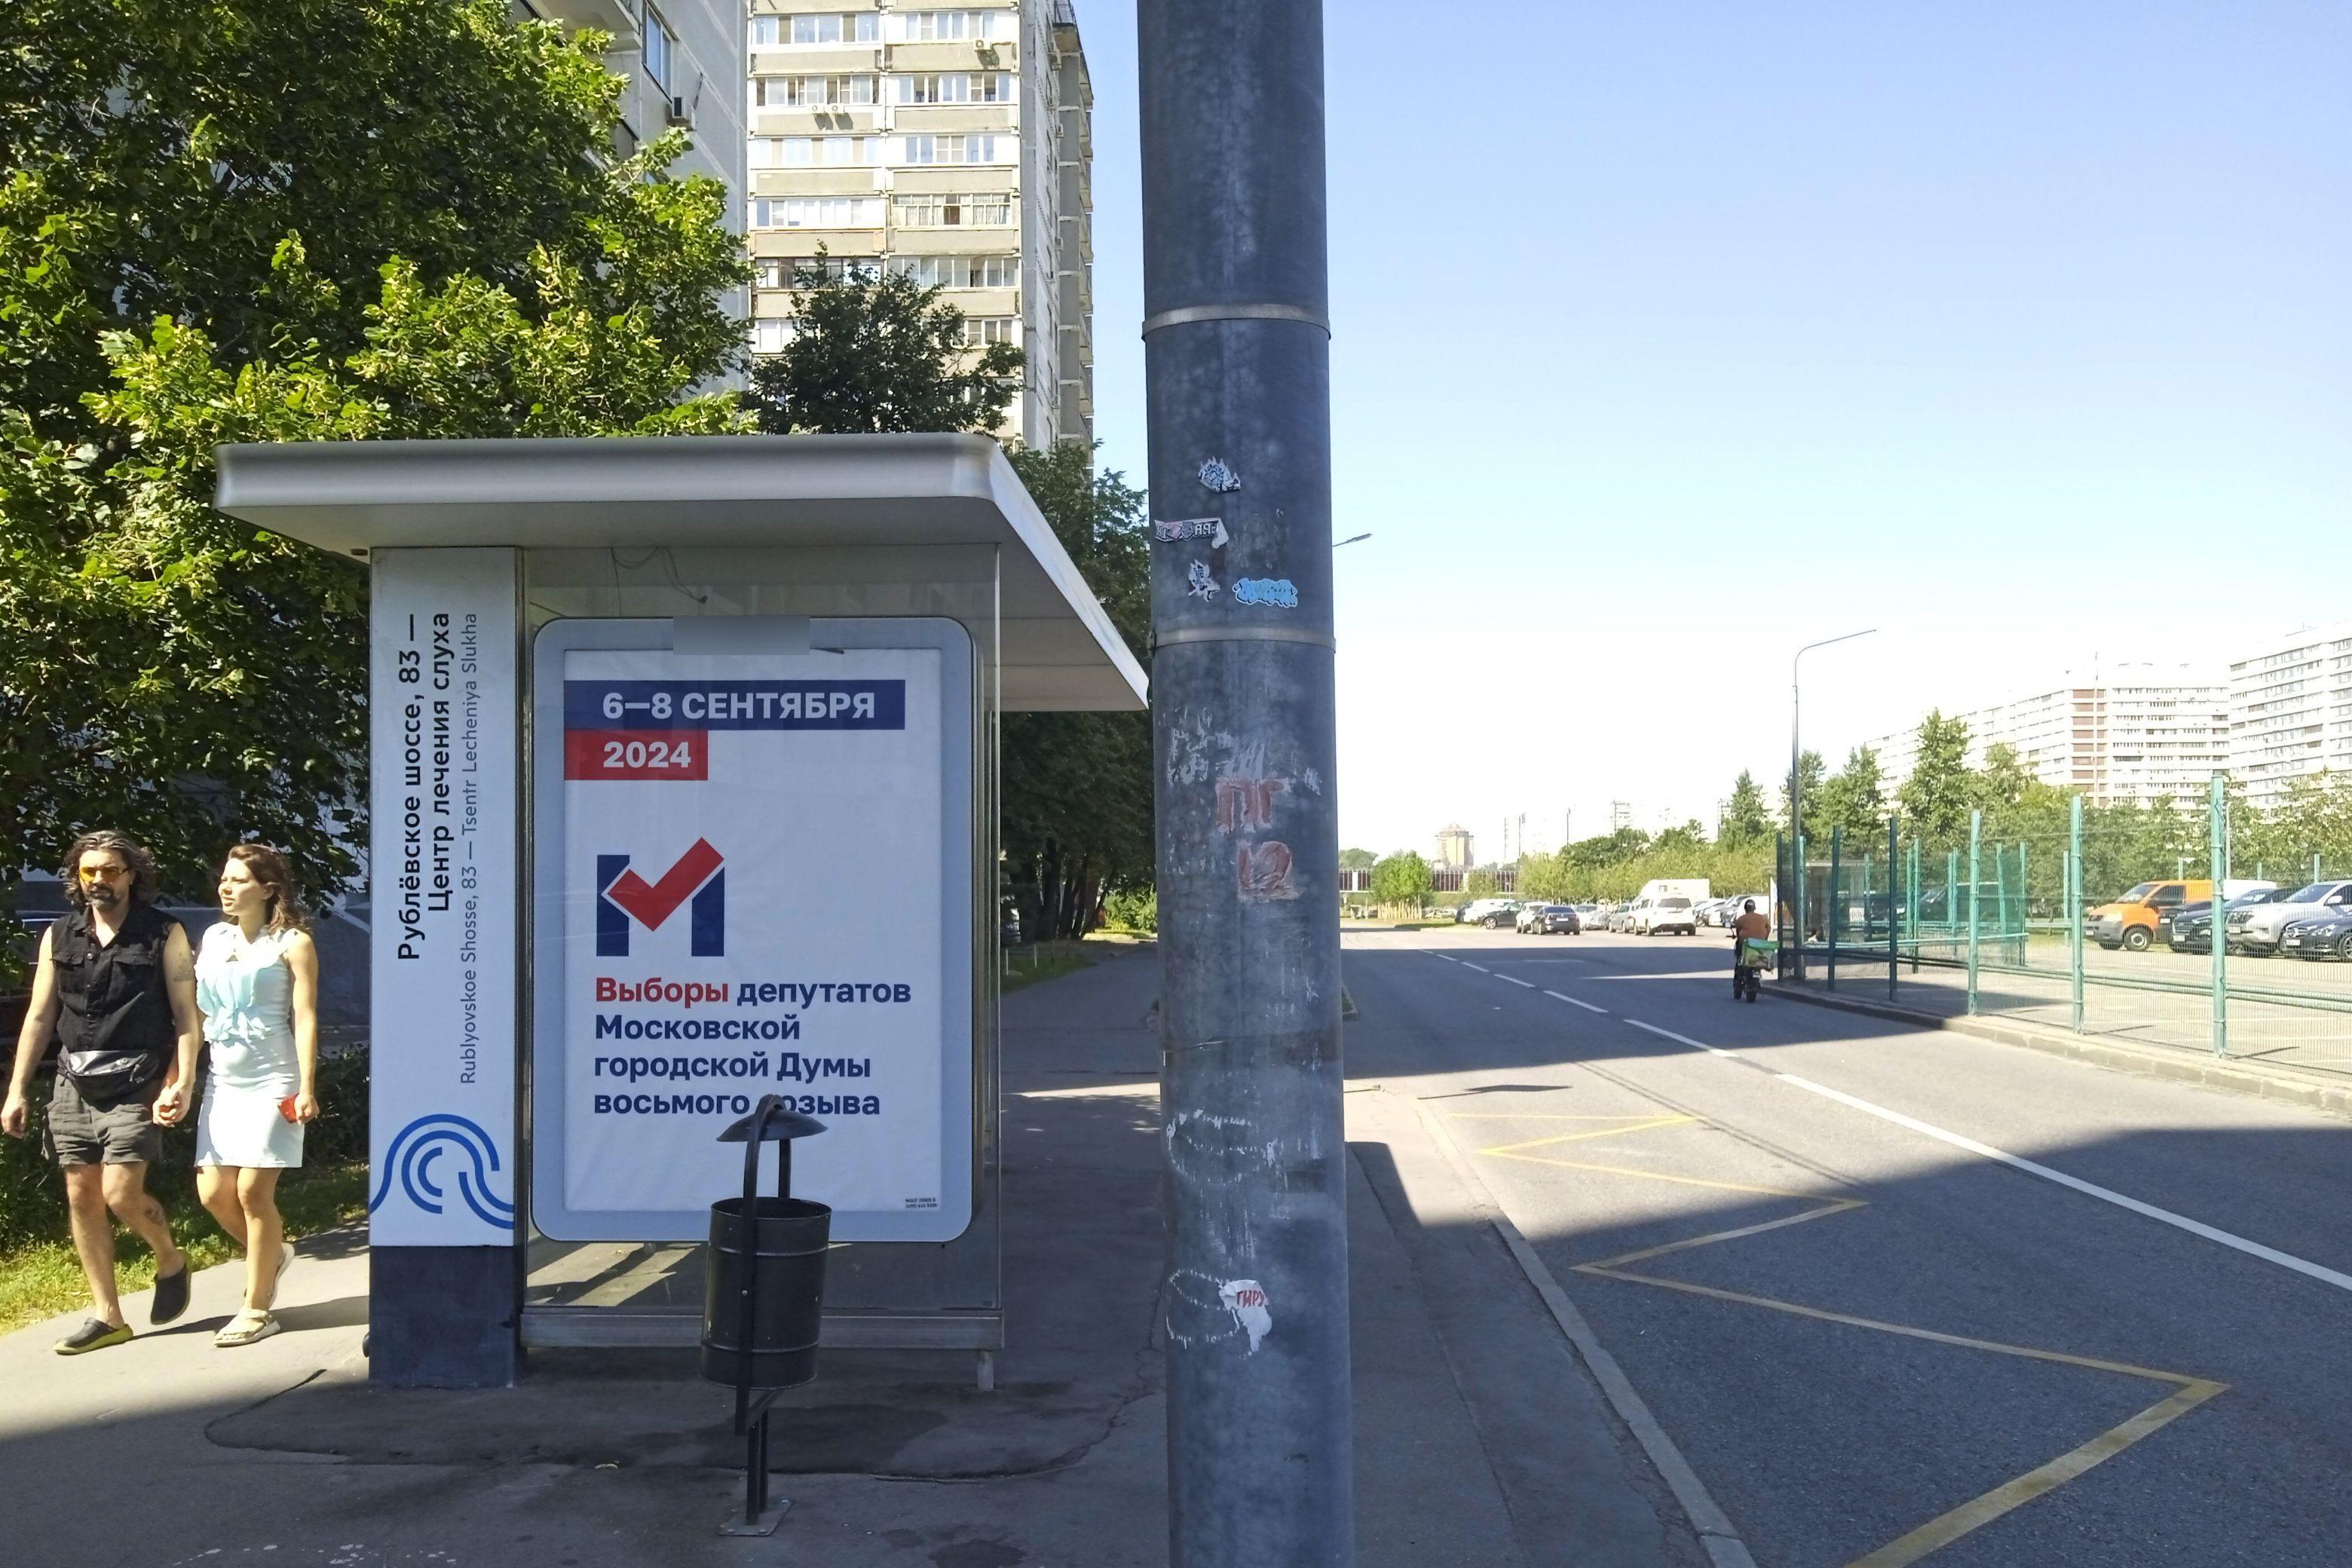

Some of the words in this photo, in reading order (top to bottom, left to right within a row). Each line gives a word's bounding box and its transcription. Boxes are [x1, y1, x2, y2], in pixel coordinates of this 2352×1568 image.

[398, 650, 421, 684] 83
[433, 613, 455, 691] слуха
[461, 613, 477, 674] Slukha
[461, 681, 481, 772] Lecheniya
[681, 692, 875, 720] СЕНТЯБРЯ
[405, 694, 425, 786] шоссе,
[433, 700, 450, 816] лечения
[603, 741, 691, 768] 2024
[461, 779, 477, 836] Tsentr
[397, 796, 426, 960] Рублёвское
[427, 825, 455, 911] Центр
[461, 866, 477, 890] 83
[461, 895, 479, 963] Shosse,
[596, 977, 728, 1009] Выборы
[737, 982, 911, 1009] депутатов
[460, 969, 479, 1083] Rublyovskoe
[596, 1013, 800, 1040] Московской
[594, 1051, 768, 1083] городской
[776, 1052, 871, 1085] Думы
[594, 1094, 750, 1115] восьмого
[779, 1094, 880, 1115] озыва
